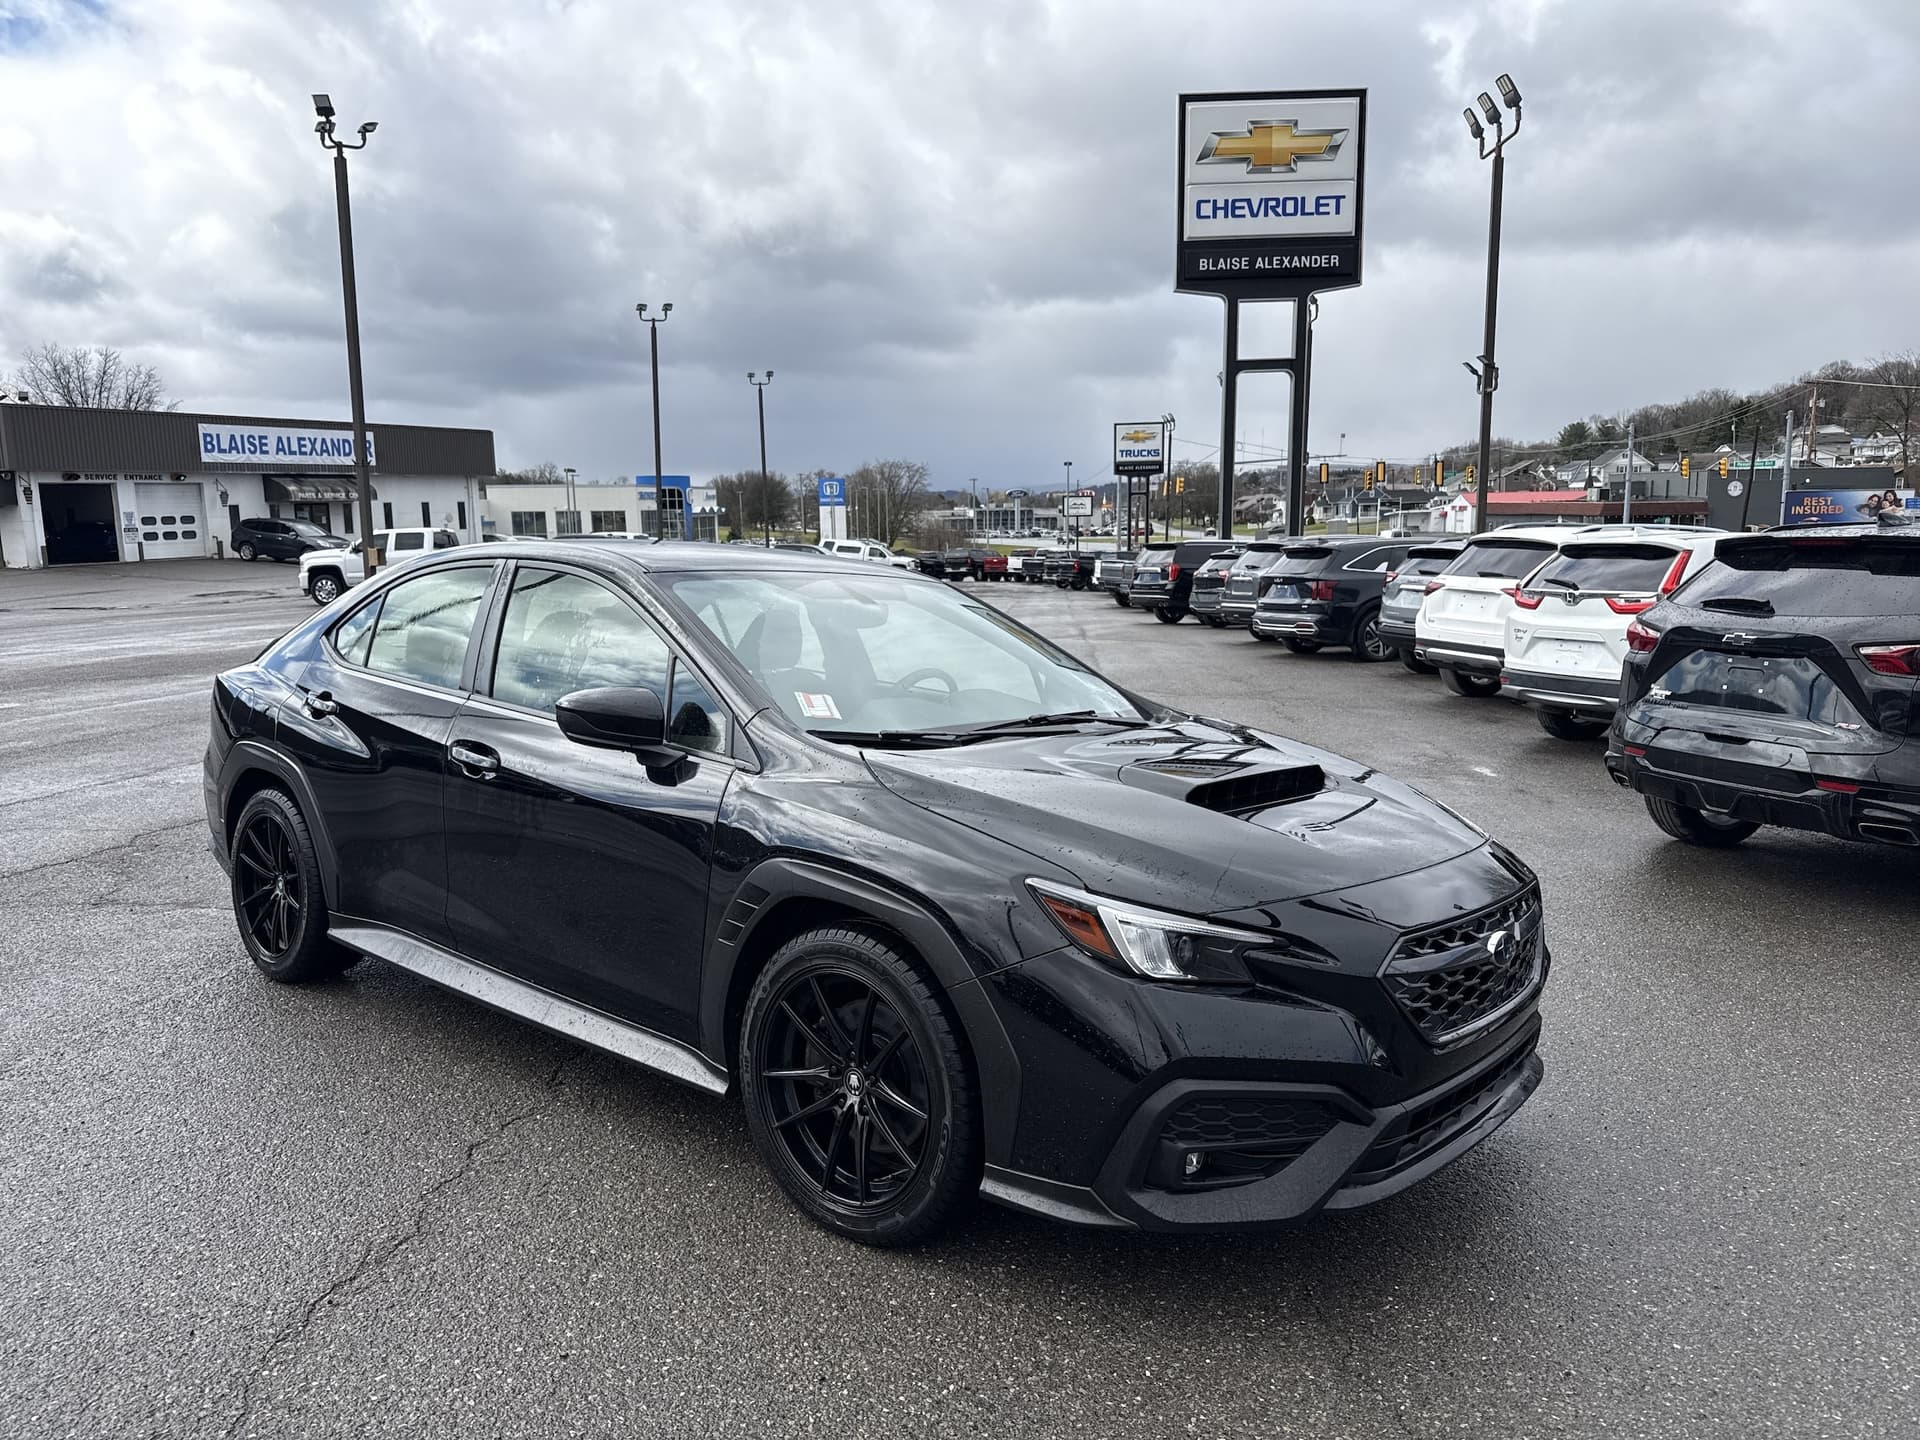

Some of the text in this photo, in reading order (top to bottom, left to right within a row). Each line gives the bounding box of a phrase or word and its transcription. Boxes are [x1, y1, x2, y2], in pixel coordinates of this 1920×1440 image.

[1195, 195, 1346, 220] CHEVROLET
[1199, 254, 1340, 271] BLAISE ALEXANDER
[202, 432, 374, 458] BLAISE ALEXANDR
[1119, 448, 1160, 458] TRUCKS
[1803, 496, 1833, 506] REST
[1791, 505, 1844, 515] INSURED
